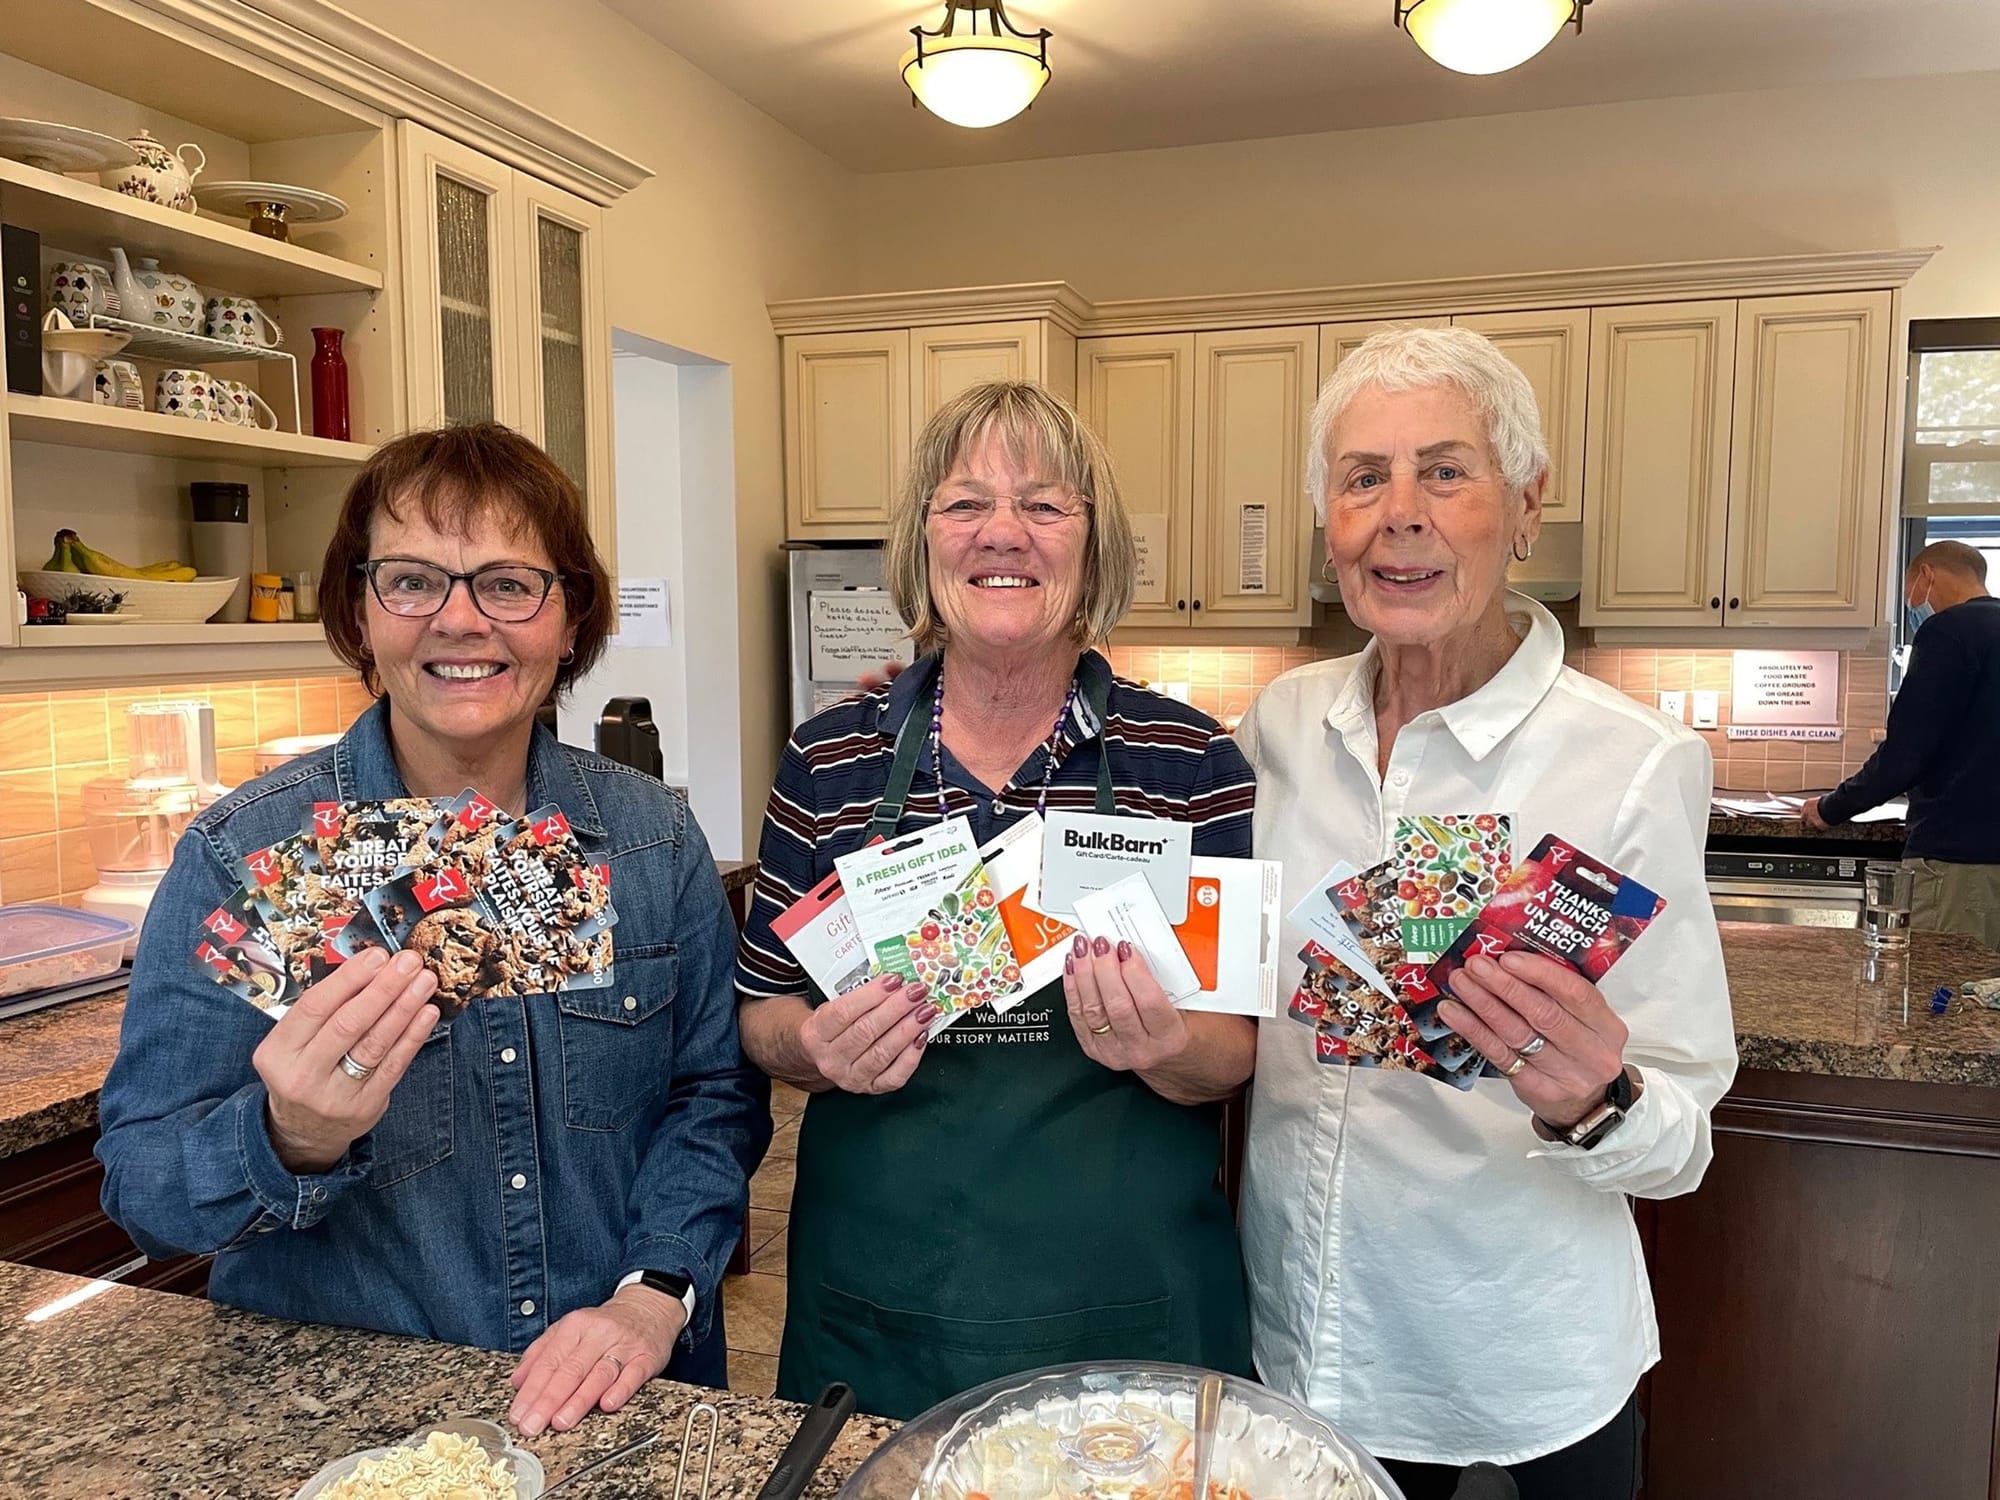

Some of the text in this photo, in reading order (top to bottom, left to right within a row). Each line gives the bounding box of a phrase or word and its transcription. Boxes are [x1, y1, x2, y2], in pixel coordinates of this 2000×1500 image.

[1735, 729, 1759, 737] THESE
[1760, 729, 1788, 737] DISHES
[1808, 730, 1837, 738] CLEAN
[351, 838, 410, 855] TREAT
[1064, 828, 1162, 855] BulkBarn
[1076, 850, 1088, 858] Gift
[320, 871, 395, 888] FAITES-
[529, 856, 563, 906] TREAT
[856, 876, 865, 888] A
[866, 863, 906, 884] FRESH
[907, 852, 935, 870] GIFT
[937, 842, 967, 860] IDEA
[482, 874, 525, 934] PLAISIR
[484, 848, 548, 950] FAITES-VOUS
[508, 849, 559, 926] YOURSELF
[1548, 880, 1613, 924] THANKS
[826, 912, 852, 938] Gift
[1524, 902, 1550, 923] UN
[1549, 918, 1595, 949] GROS
[1534, 889, 1608, 936] A BUNCH
[1524, 918, 1577, 954] MERCI
[955, 1033, 993, 1044] STORY
[997, 1031, 1050, 1044] MATTERS
